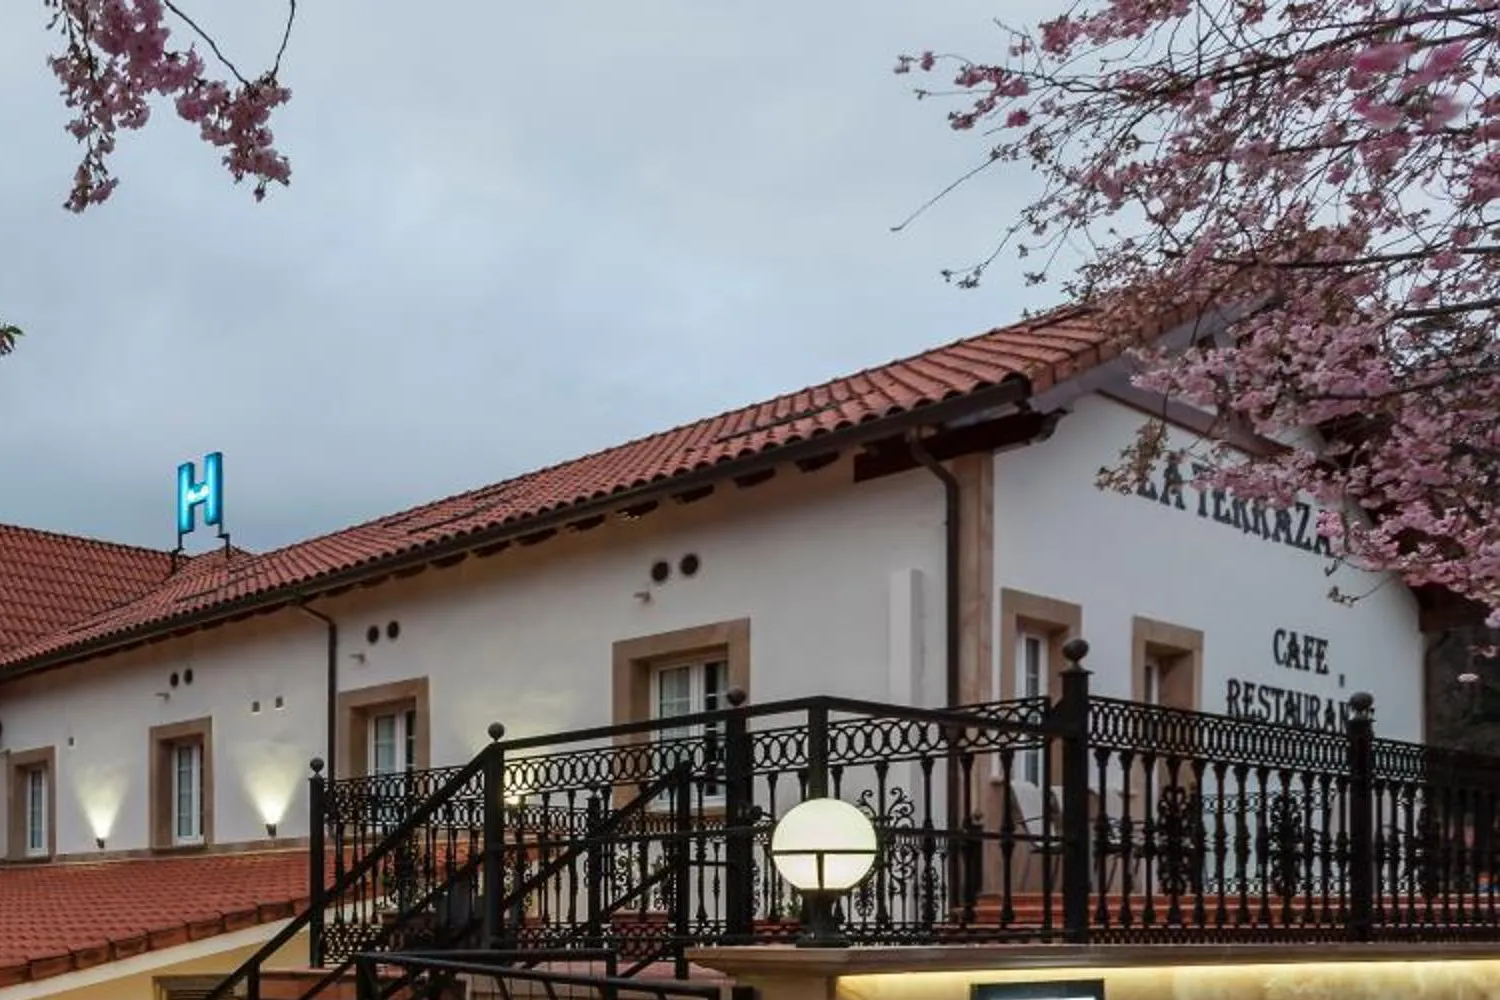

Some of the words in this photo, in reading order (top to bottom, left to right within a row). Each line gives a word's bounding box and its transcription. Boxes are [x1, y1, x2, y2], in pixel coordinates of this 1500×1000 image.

[178, 452, 222, 534] H
[1273, 627, 1329, 675] CAFE
[1227, 679, 1374, 736] RESTAURAN
